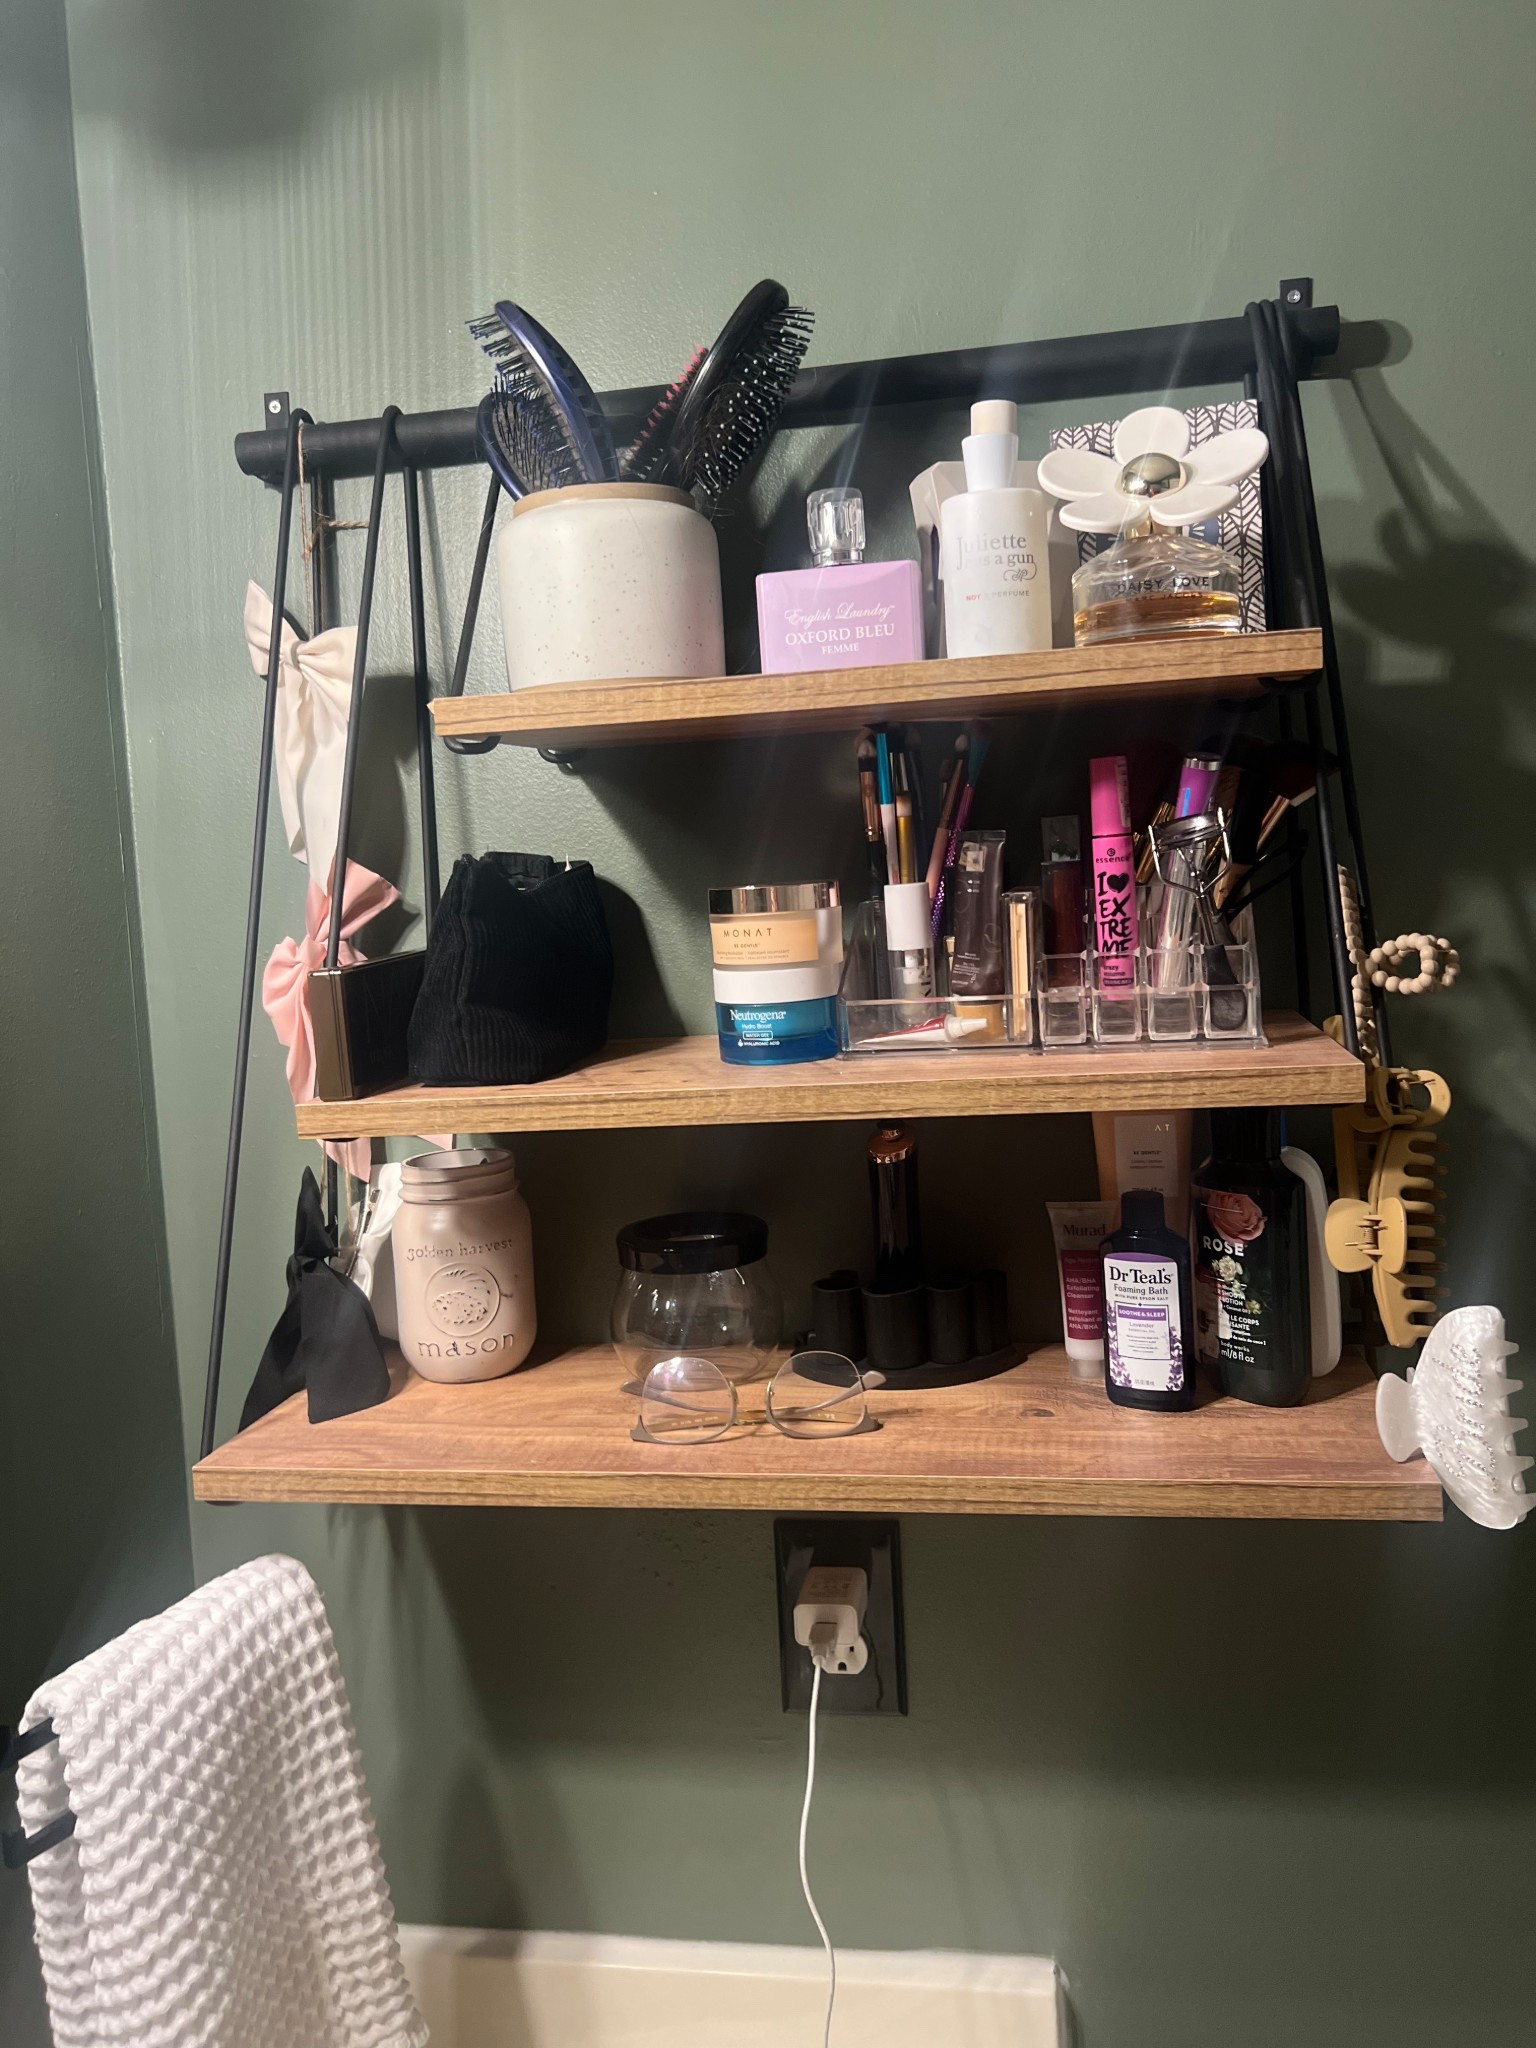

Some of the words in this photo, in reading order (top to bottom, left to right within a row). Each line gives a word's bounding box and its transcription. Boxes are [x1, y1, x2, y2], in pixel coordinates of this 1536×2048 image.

[956, 533, 1028, 570] Juliette
[994, 555, 1004, 565] a
[1007, 553, 1035, 568] gun
[1117, 579, 1162, 594] DAISY
[1172, 576, 1209, 589] LOVE
[965, 593, 982, 601] NOT
[991, 590, 1030, 598] PERFUME
[784, 608, 833, 630] English
[834, 602, 891, 624] Laundry
[785, 628, 851, 646] OXFORD
[855, 623, 896, 639] BLEU
[821, 643, 860, 655] FEMME
[1097, 871, 1109, 897] I
[1099, 893, 1132, 919] EX
[723, 928, 772, 938] MONAT
[1099, 917, 1133, 940] TRE
[729, 1009, 785, 1024] Neutrogena
[406, 1246, 454, 1262] golden
[458, 1238, 513, 1256] harvest
[1203, 1235, 1245, 1257] ROSE
[1109, 1266, 1129, 1283] Dr
[1129, 1267, 1172, 1285] Teal's
[1113, 1283, 1146, 1296] Foaming
[1148, 1286, 1169, 1295] Bath
[1230, 1314, 1238, 1322] LE
[1238, 1316, 1260, 1326] CORPS
[417, 1332, 515, 1358] mason
[1244, 1355, 1256, 1364] oz
